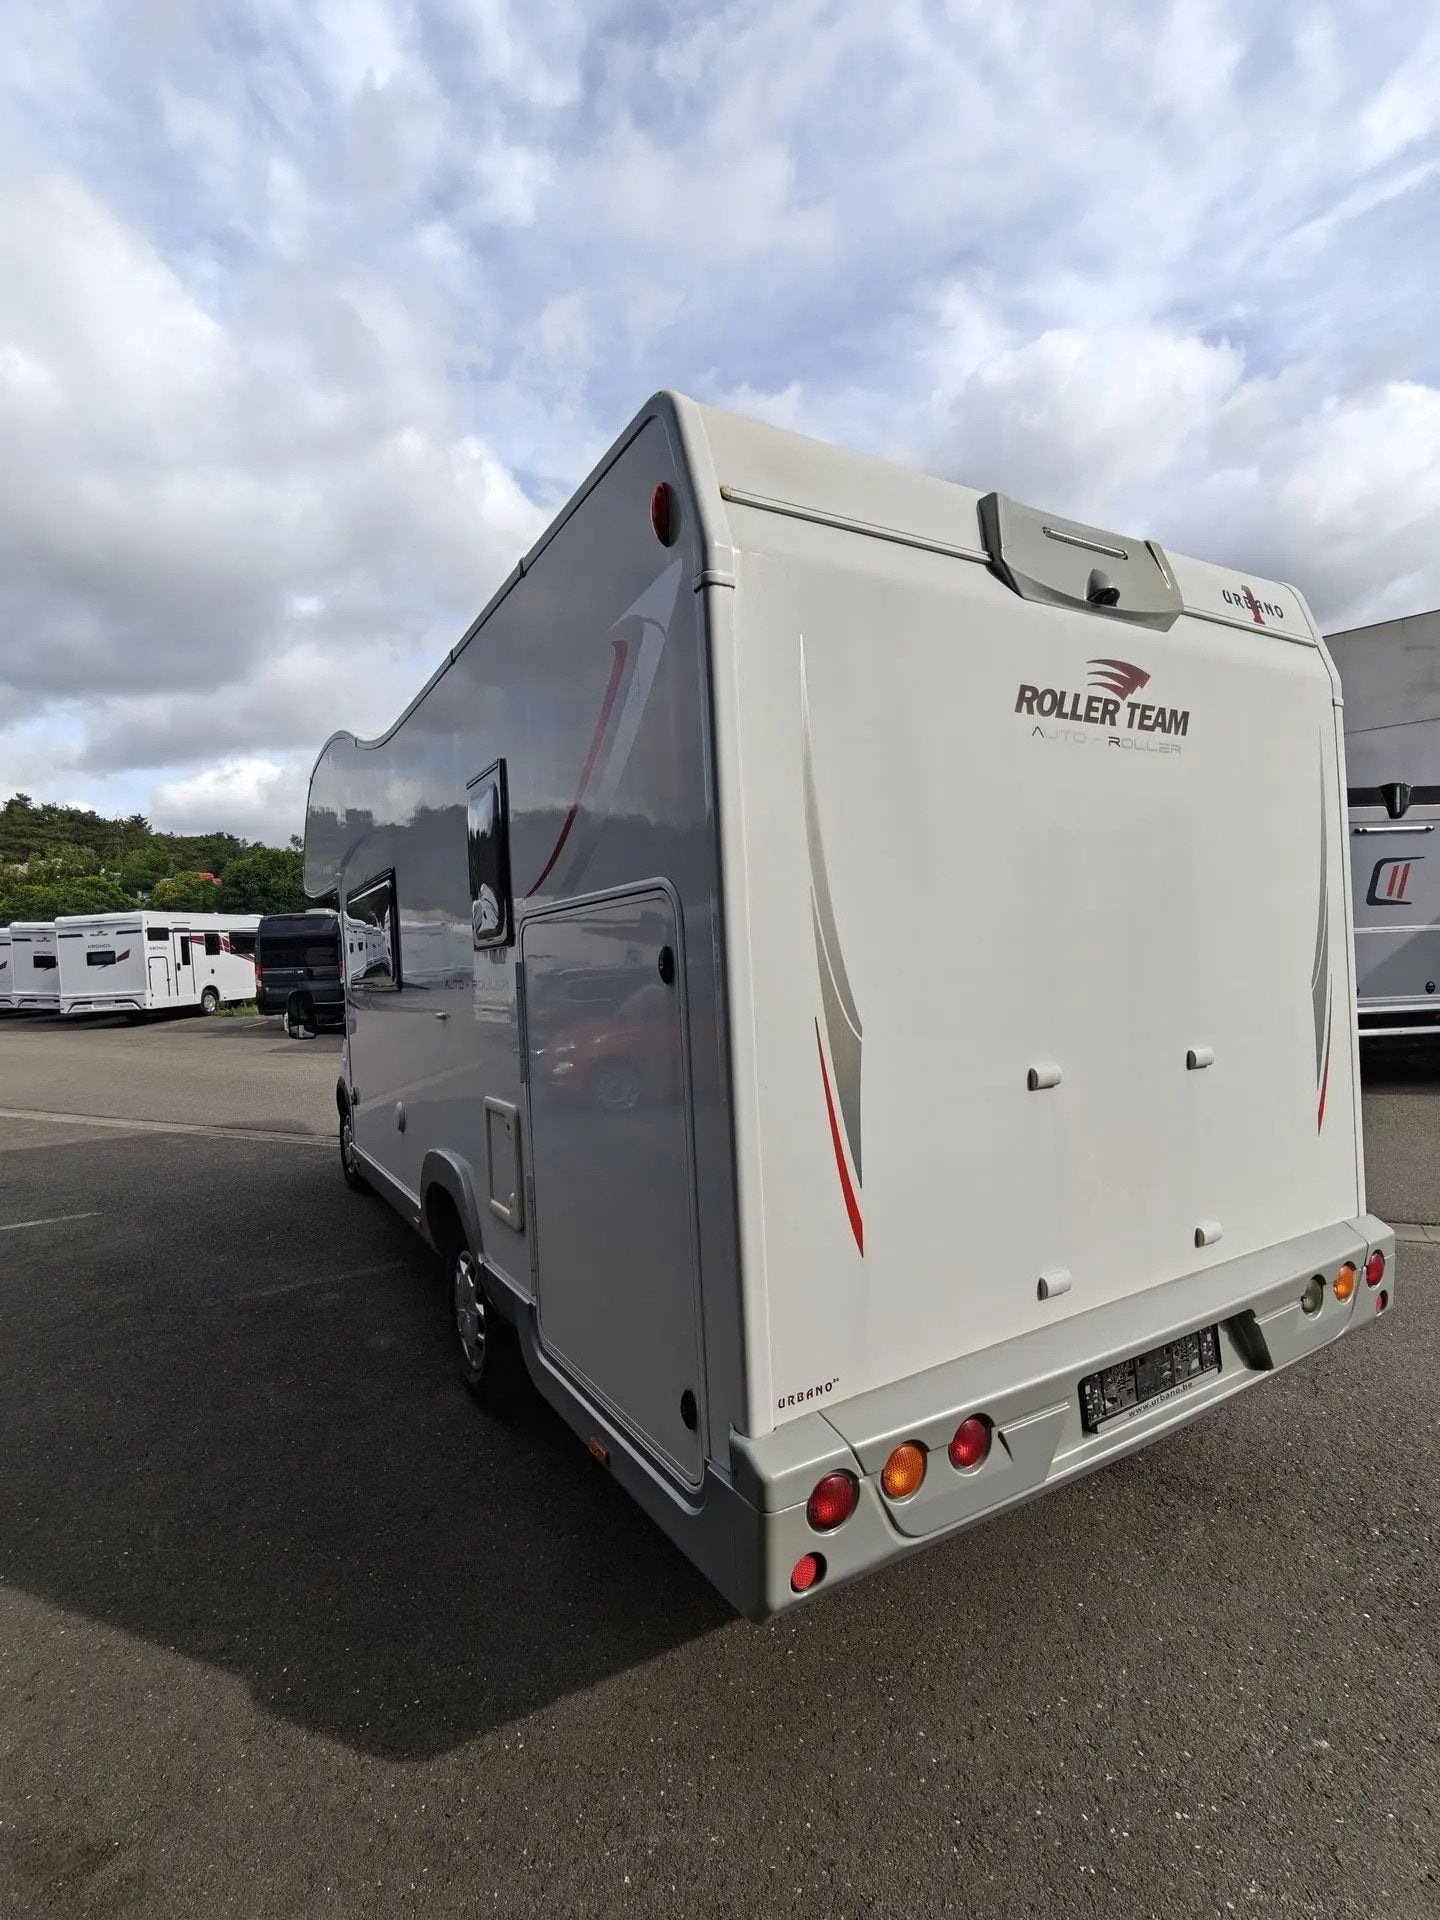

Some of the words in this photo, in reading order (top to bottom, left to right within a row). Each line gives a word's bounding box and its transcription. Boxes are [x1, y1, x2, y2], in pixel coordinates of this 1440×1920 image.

[1014, 684, 1121, 727] ROLLER
[1126, 701, 1190, 736] TEAM
[1108, 736, 1182, 755] ROLLER
[777, 1381, 833, 1409] URBANO
[1128, 1382, 1194, 1418] www.urbano.be
